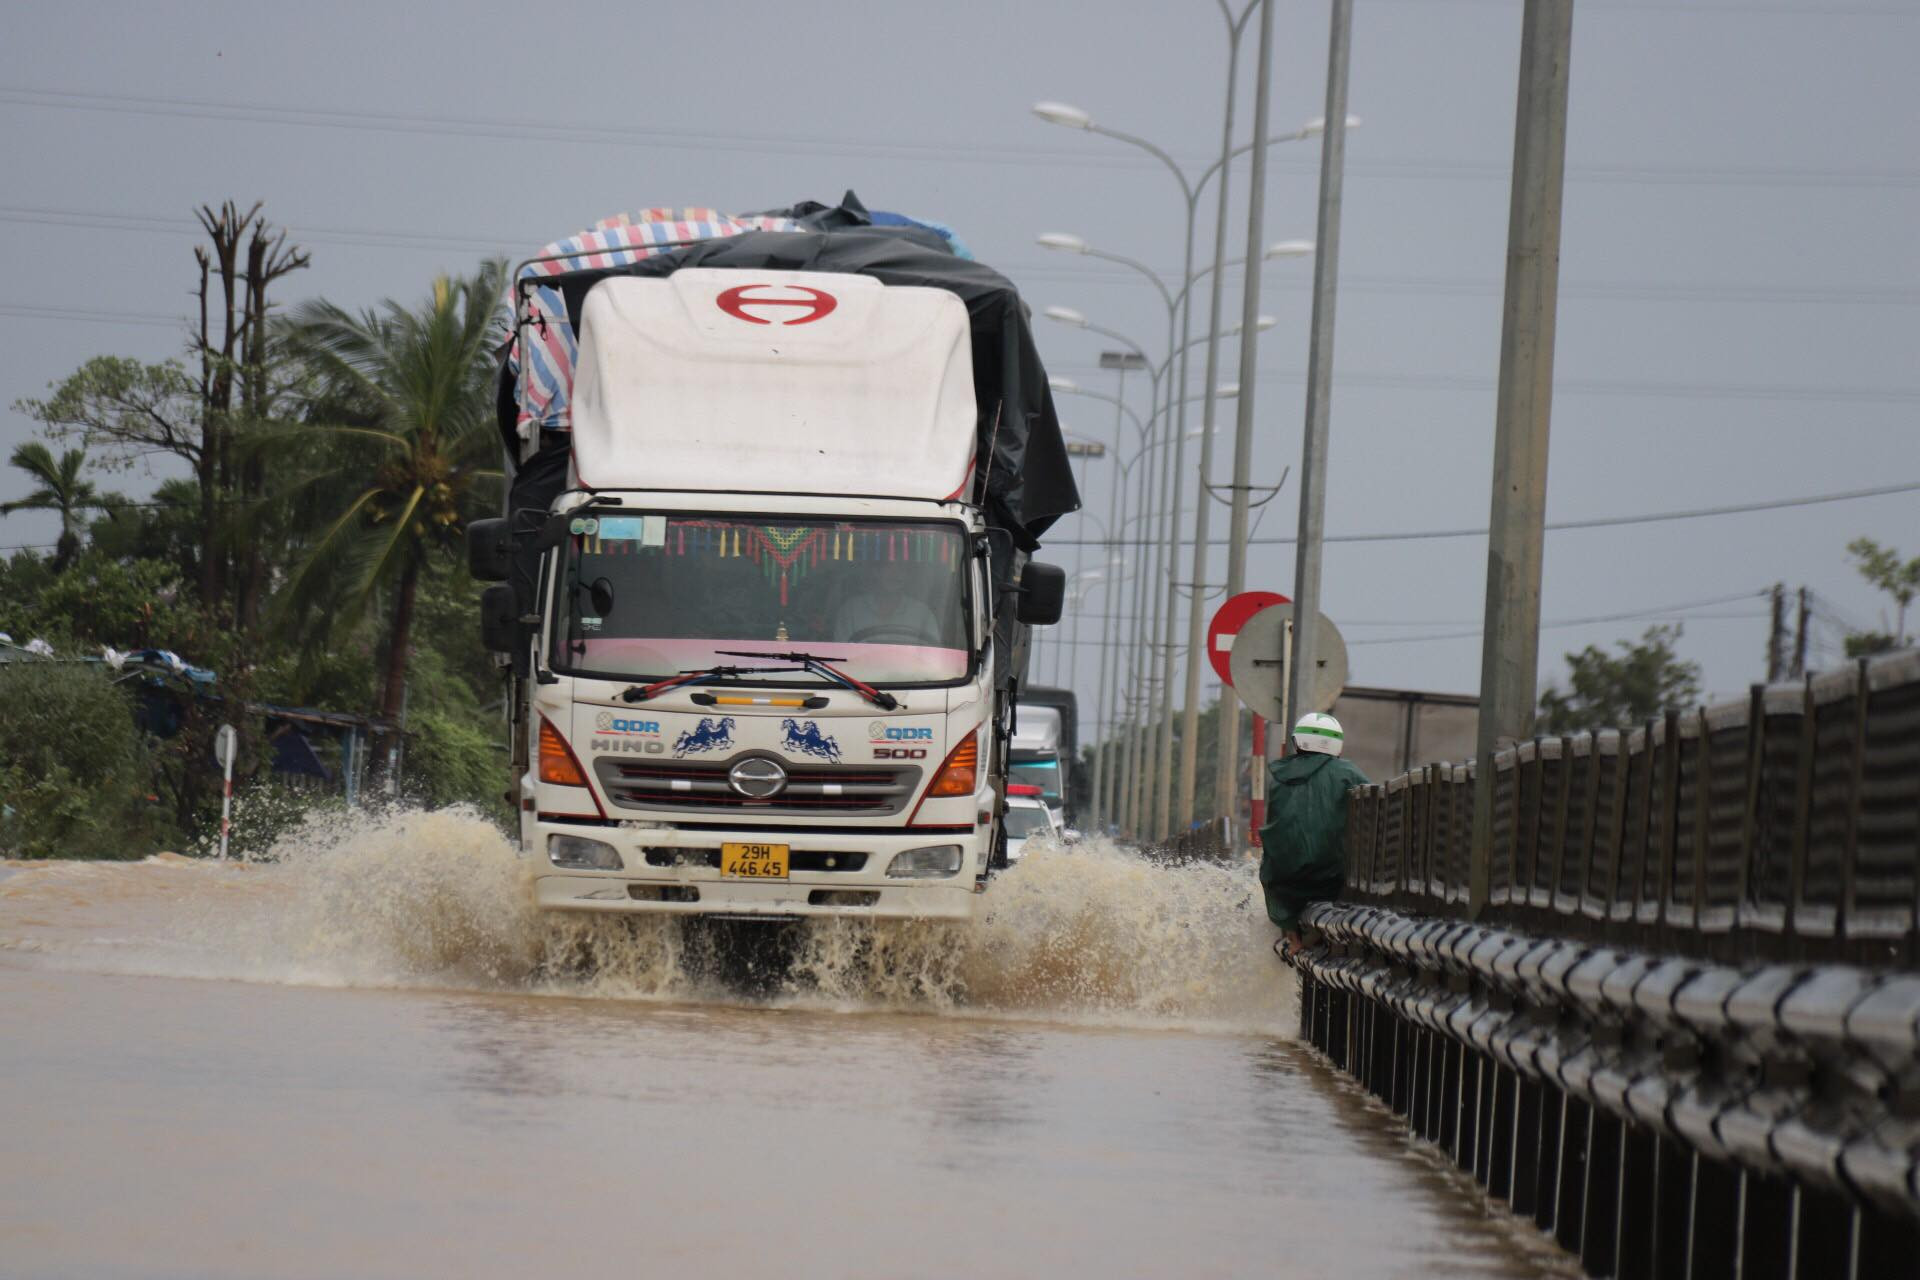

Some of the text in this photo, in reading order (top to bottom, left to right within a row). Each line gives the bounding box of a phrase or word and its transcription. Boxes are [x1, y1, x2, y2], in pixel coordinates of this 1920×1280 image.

[612, 719, 660, 733] QDR
[885, 727, 933, 741] QDR
[590, 739, 665, 754] HINO
[873, 748, 927, 760] 500
[741, 845, 770, 860] 29H
